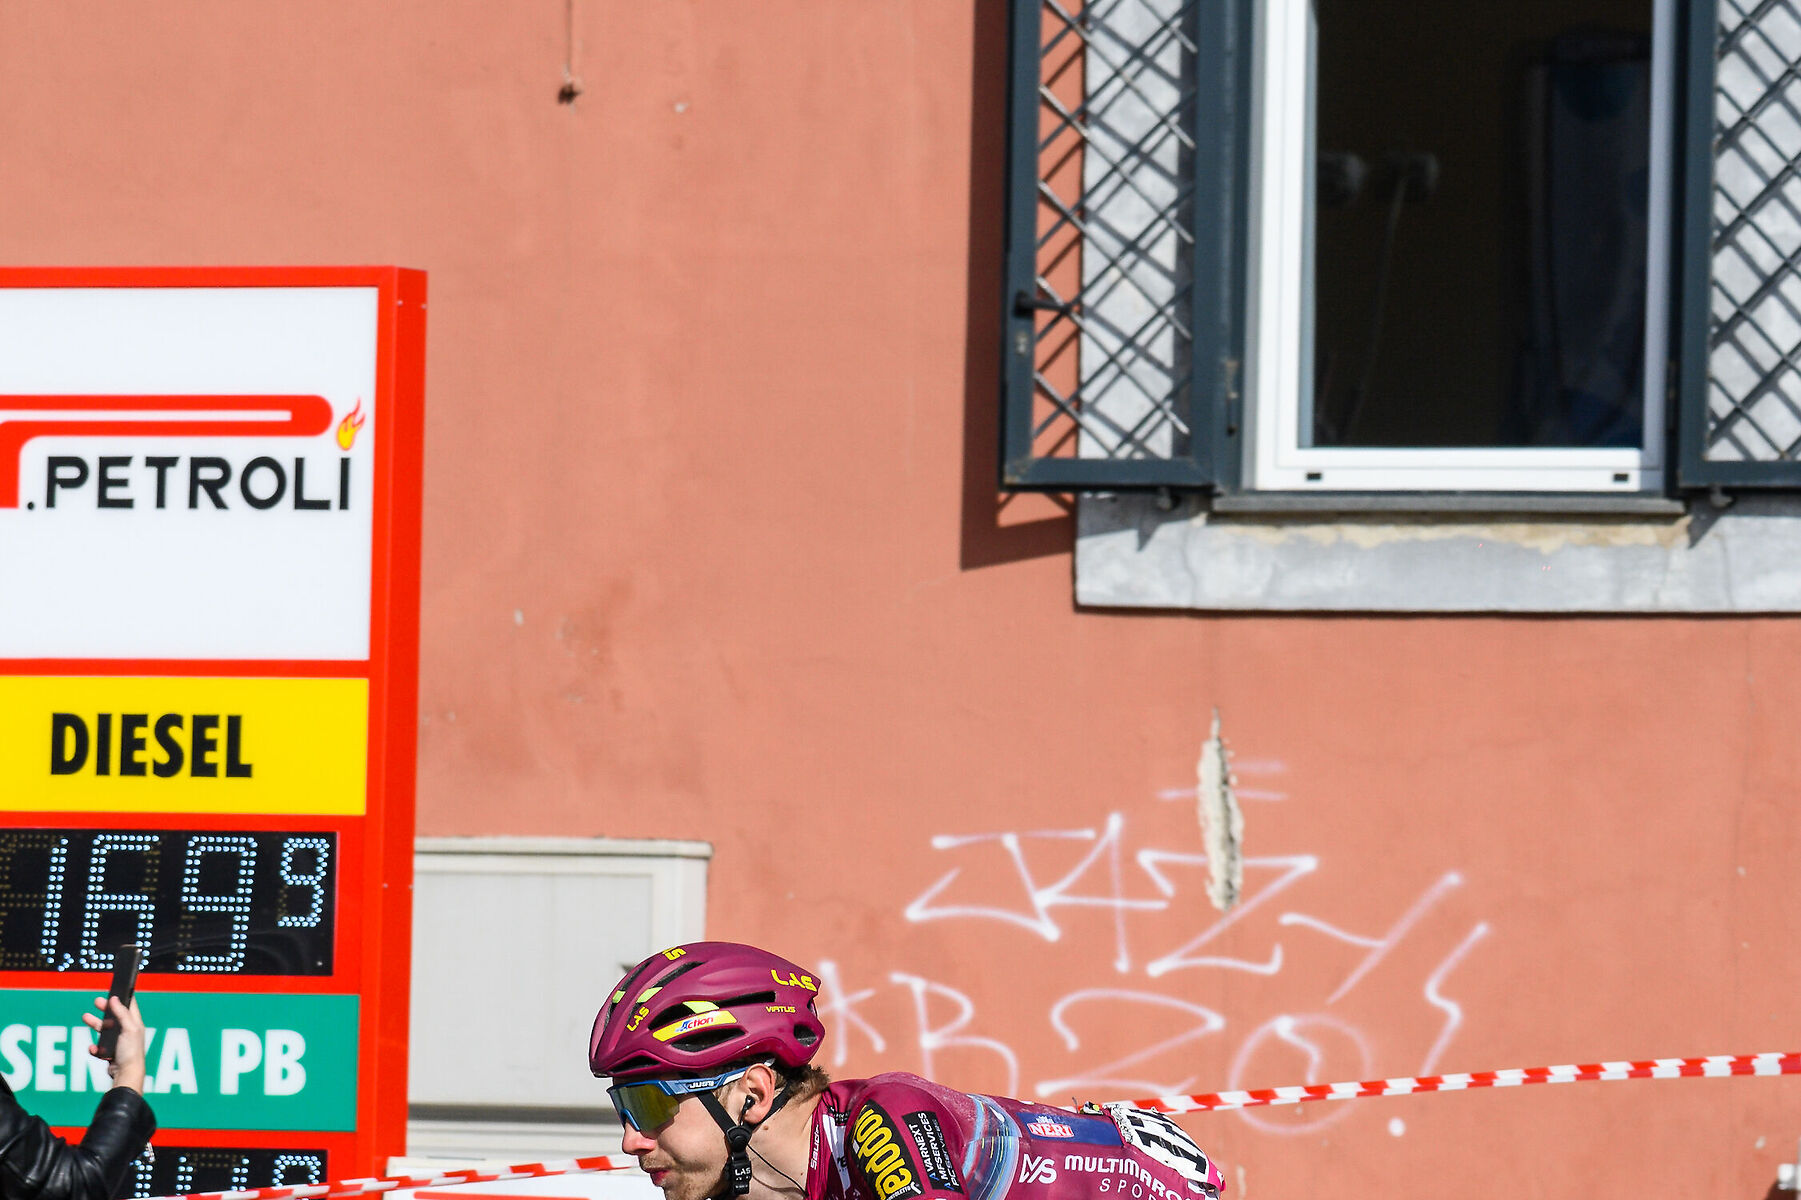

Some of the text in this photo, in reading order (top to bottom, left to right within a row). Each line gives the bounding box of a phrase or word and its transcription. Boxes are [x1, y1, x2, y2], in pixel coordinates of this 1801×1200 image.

[50, 712, 253, 779] DIESEL
[770, 968, 818, 992] LAS
[626, 1006, 650, 1032] LAS
[765, 1005, 796, 1014] VIRTUS
[0, 1023, 307, 1096] SENA PB
[1027, 1121, 1075, 1138] NERI
[909, 1123, 934, 1173] VARNEXT
[735, 1167, 751, 1176] LAS
